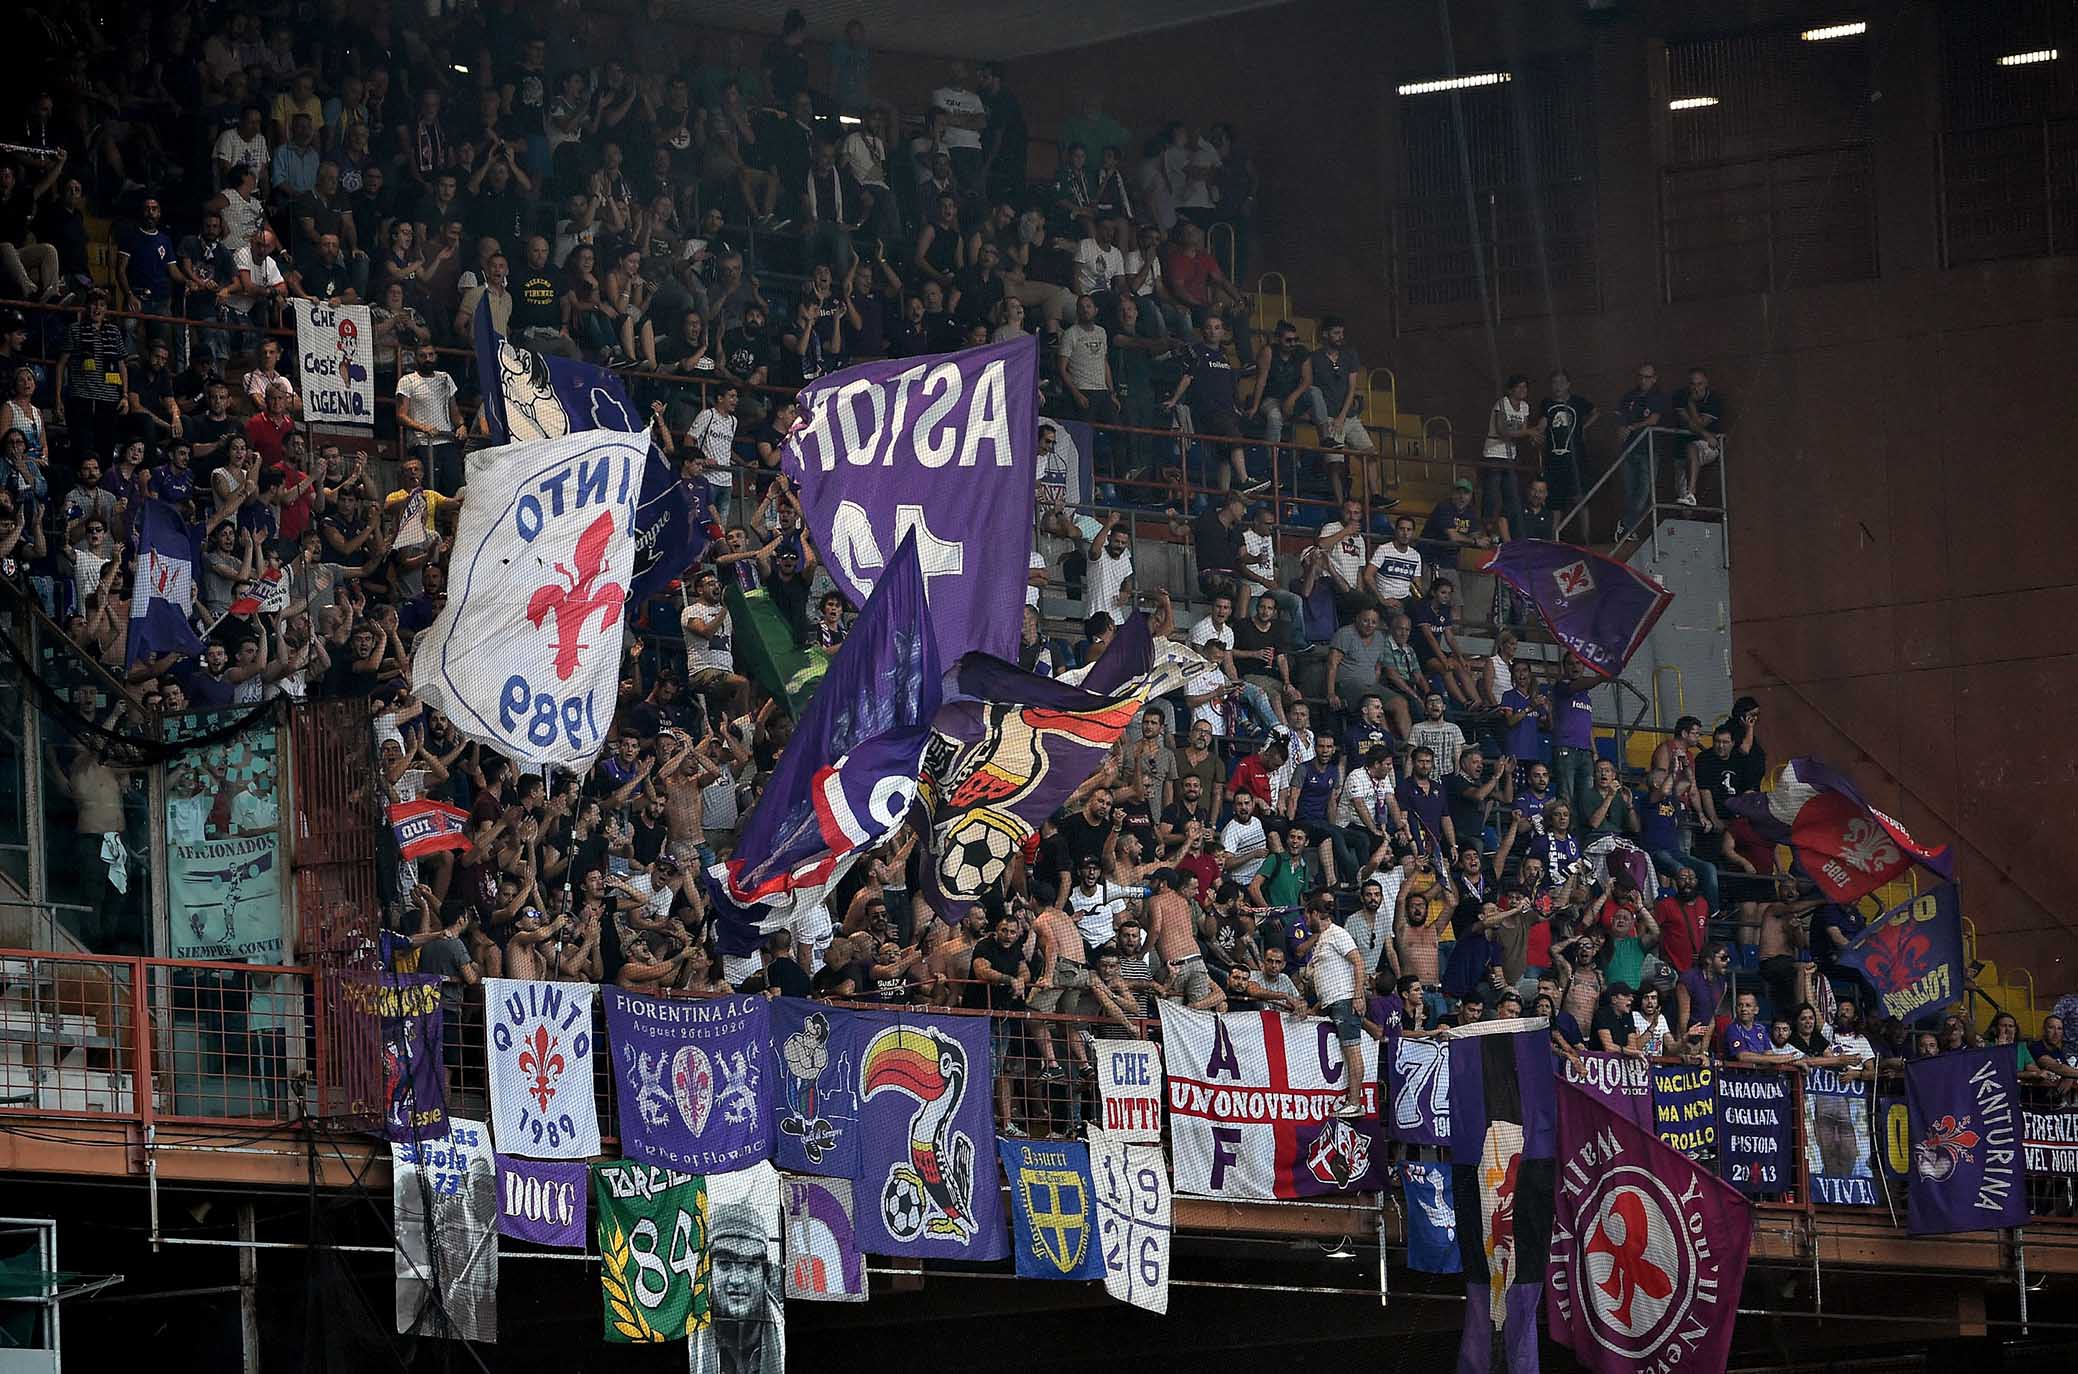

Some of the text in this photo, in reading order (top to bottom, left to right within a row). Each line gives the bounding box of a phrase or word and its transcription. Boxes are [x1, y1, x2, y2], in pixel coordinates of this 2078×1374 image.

[311, 307, 335, 327] CHE
[635, 510, 671, 552] empre
[177, 836, 276, 859] AFICIONADOS
[178, 938, 284, 958] SIEMPRE CONTI
[493, 984, 590, 1059] QUINTO
[616, 994, 759, 1023] FIORENTINA A.C.
[634, 1020, 676, 1038] August
[1207, 1016, 1344, 1084] A C
[1112, 1052, 1150, 1086] CHE
[1655, 1069, 1712, 1093] VACILLO
[1658, 1098, 1713, 1122] MA NON
[1725, 1107, 1779, 1126] GIGLIATA
[519, 1107, 577, 1148] 1989
[1660, 1127, 1714, 1151] CROLLO
[1969, 1060, 2014, 1211] VENTURINA
[2022, 1111, 2078, 1142] FIRENZE
[1731, 1136, 1777, 1154] PISTOIA
[1210, 1127, 1242, 1190] F
[435, 1173, 460, 1196] 73
[1732, 1165, 1777, 1182] 20 13
[504, 1170, 576, 1226] DOCG
[629, 1208, 699, 1308] 84
